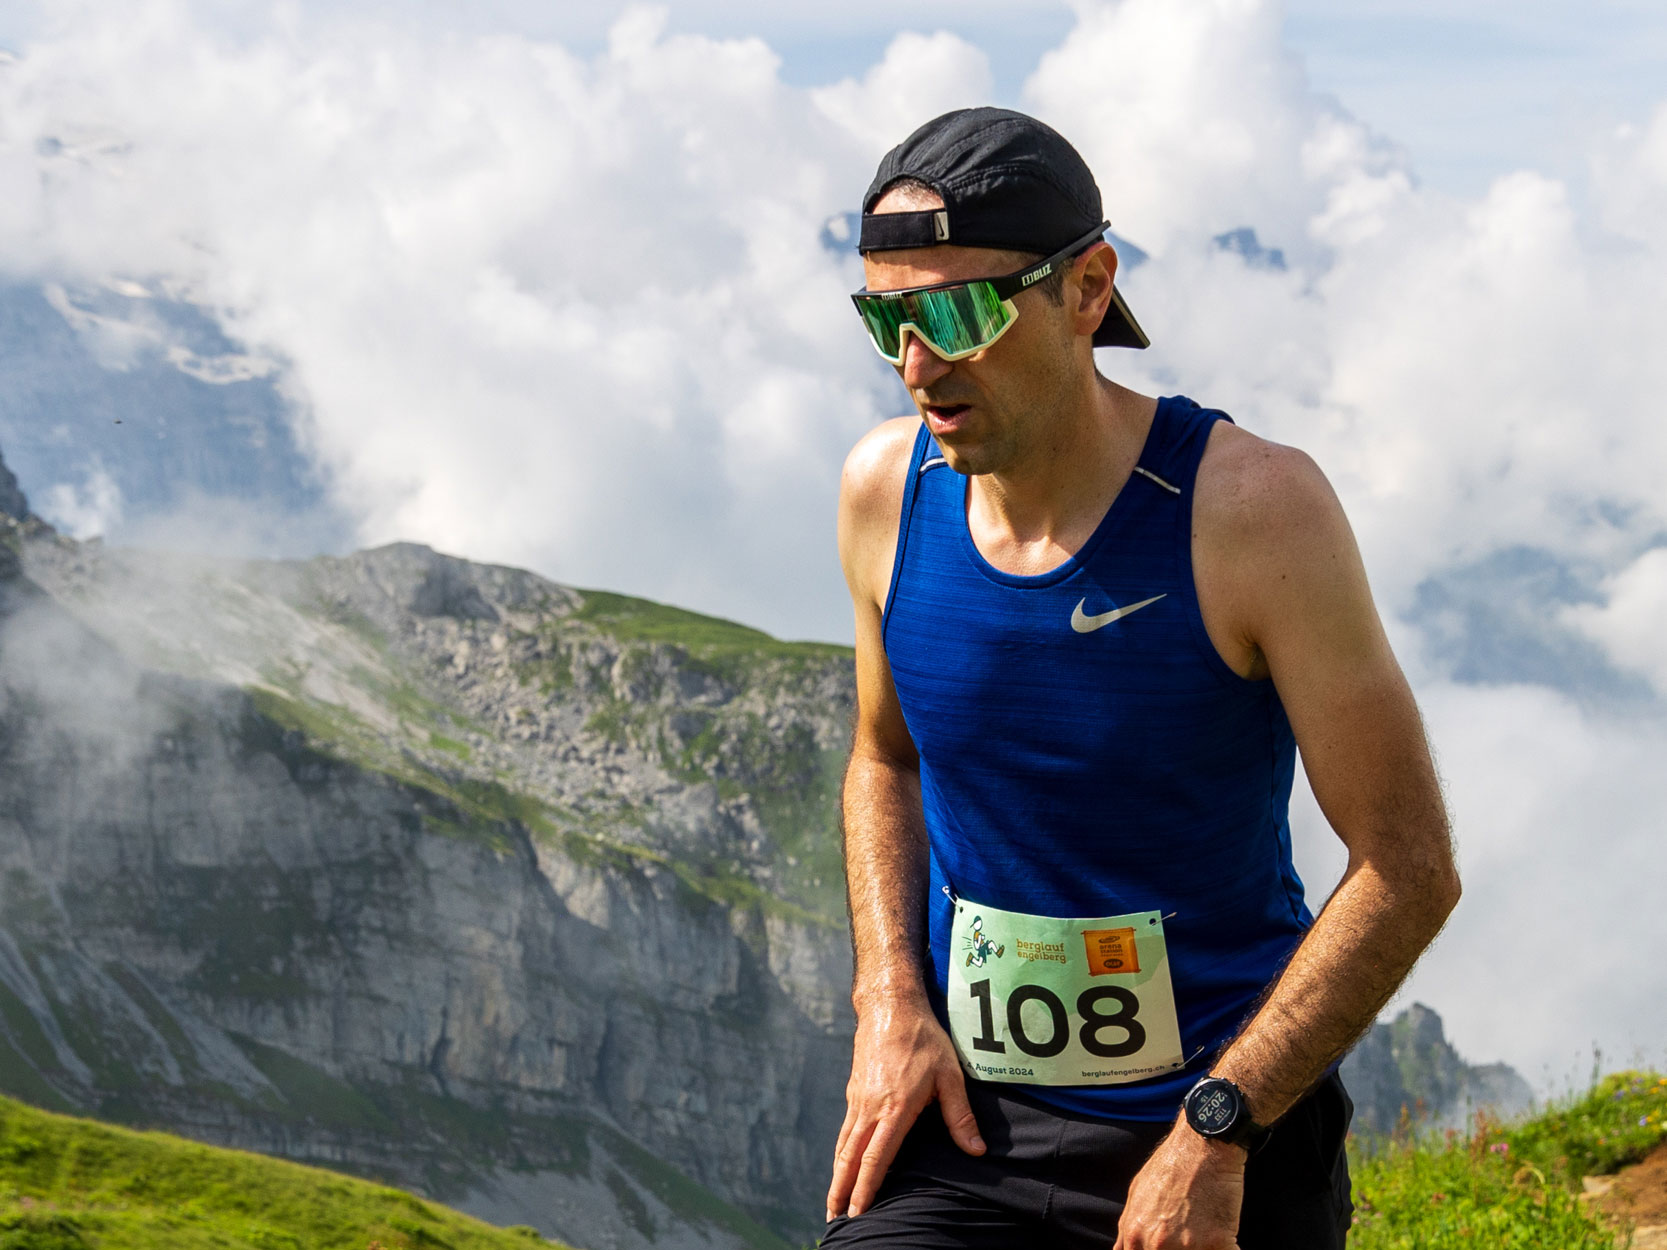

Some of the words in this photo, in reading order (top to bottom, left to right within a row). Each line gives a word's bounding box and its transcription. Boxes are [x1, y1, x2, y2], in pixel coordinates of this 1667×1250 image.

[1033, 263, 1052, 281] BLIZ
[1016, 938, 1065, 953] berglauf
[1017, 951, 1067, 965] engelberg
[970, 978, 1147, 1059] 108
[976, 1063, 1007, 1076] August
[1008, 1067, 1034, 1076] 2024
[1081, 1065, 1165, 1078] berglaufengelberg.ch
